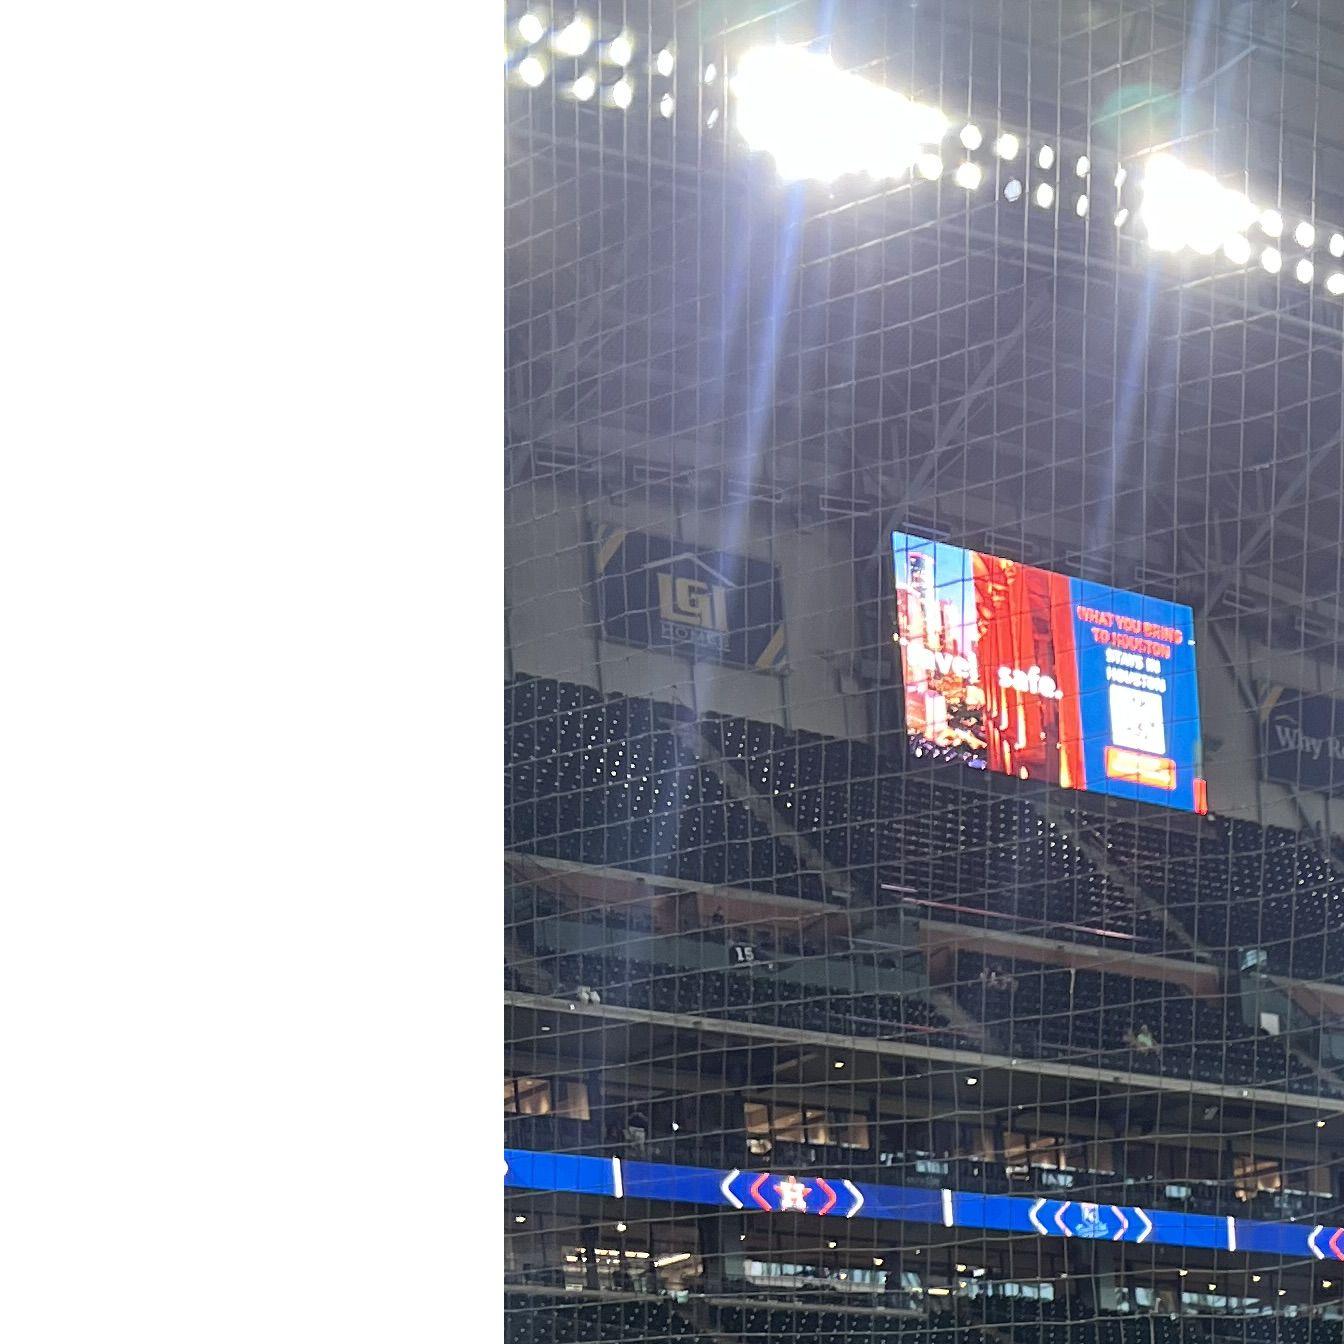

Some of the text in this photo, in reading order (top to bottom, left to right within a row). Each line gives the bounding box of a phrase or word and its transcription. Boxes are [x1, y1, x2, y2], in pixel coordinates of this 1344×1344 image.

[1115, 615, 1141, 634] YOU
[1091, 627, 1110, 643] TO
[997, 665, 1063, 698] safe.
[1275, 725, 1322, 760] Why
[736, 947, 754, 961] 15
